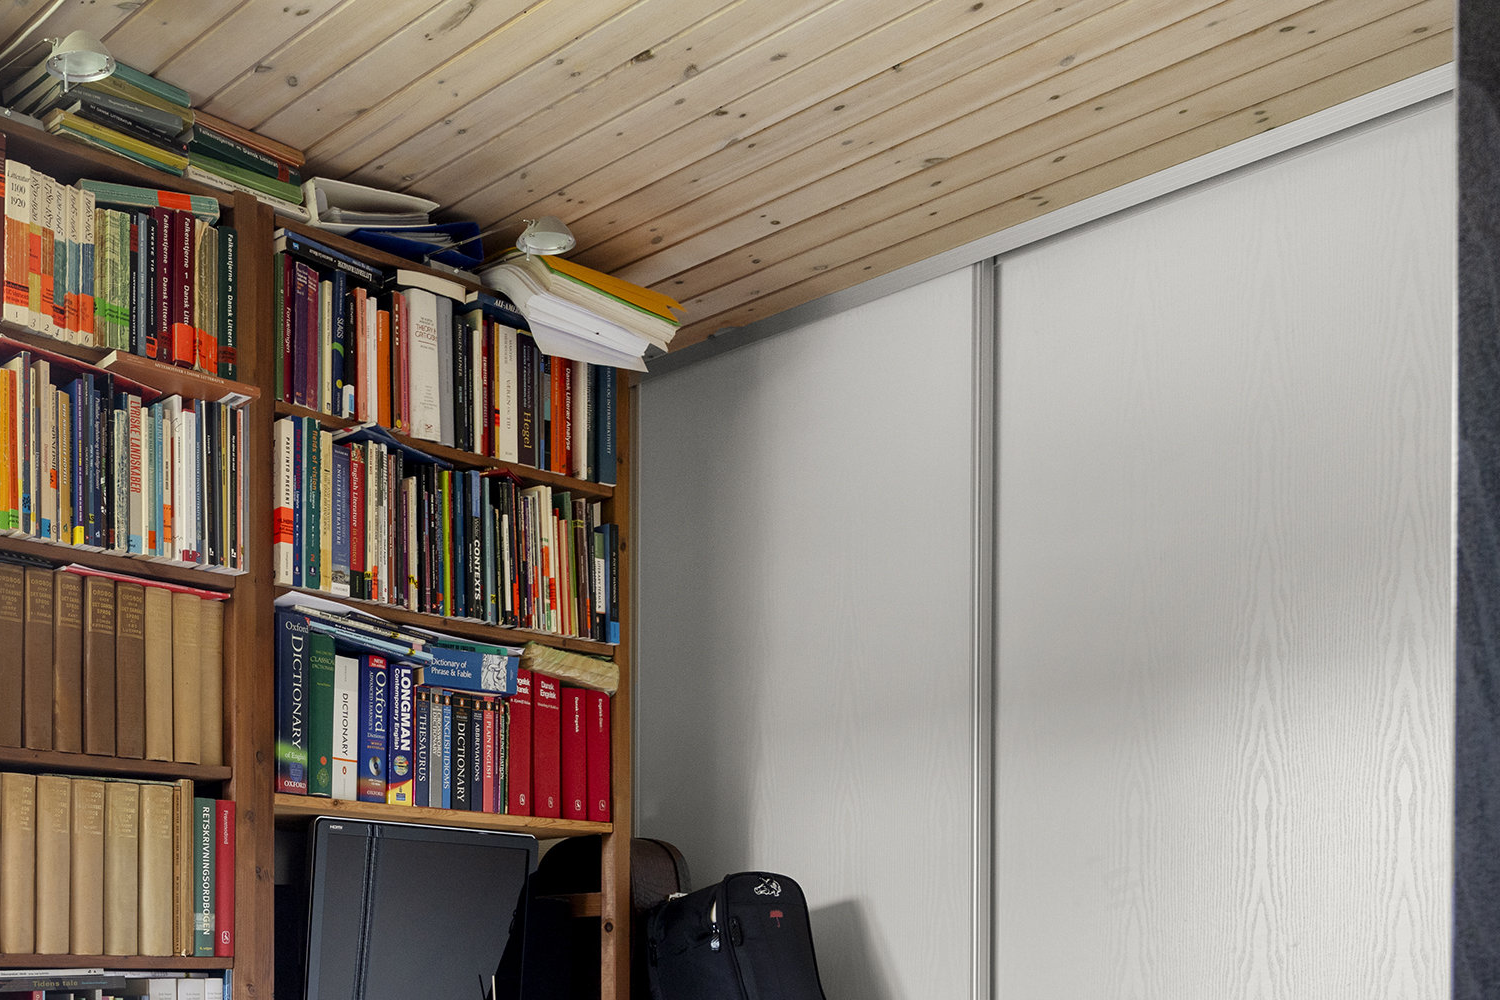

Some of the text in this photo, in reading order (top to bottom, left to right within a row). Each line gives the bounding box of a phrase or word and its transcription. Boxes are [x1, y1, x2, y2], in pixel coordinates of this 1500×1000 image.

[161, 215, 170, 264] Falkenstjerne
[182, 217, 191, 269] Falkenstjerne
[225, 234, 234, 282] Falkenstjerne
[161, 277, 170, 299] Dansk
[182, 285, 191, 306] Dansk
[225, 295, 234, 317] Dansk
[130, 401, 141, 493] LYRISKE LANDSKABER
[522, 412, 532, 449] Hegel
[285, 621, 309, 633] Oxford
[430, 657, 458, 667] Dictionary
[431, 667, 449, 678] Phrase
[456, 671, 473, 679] Fable
[292, 634, 304, 750] DICTIONARY
[375, 671, 386, 732] Oxford
[401, 668, 411, 750] LONGMAN
[419, 714, 427, 782] THESAURUS
[457, 723, 466, 801] DICTIONARY
